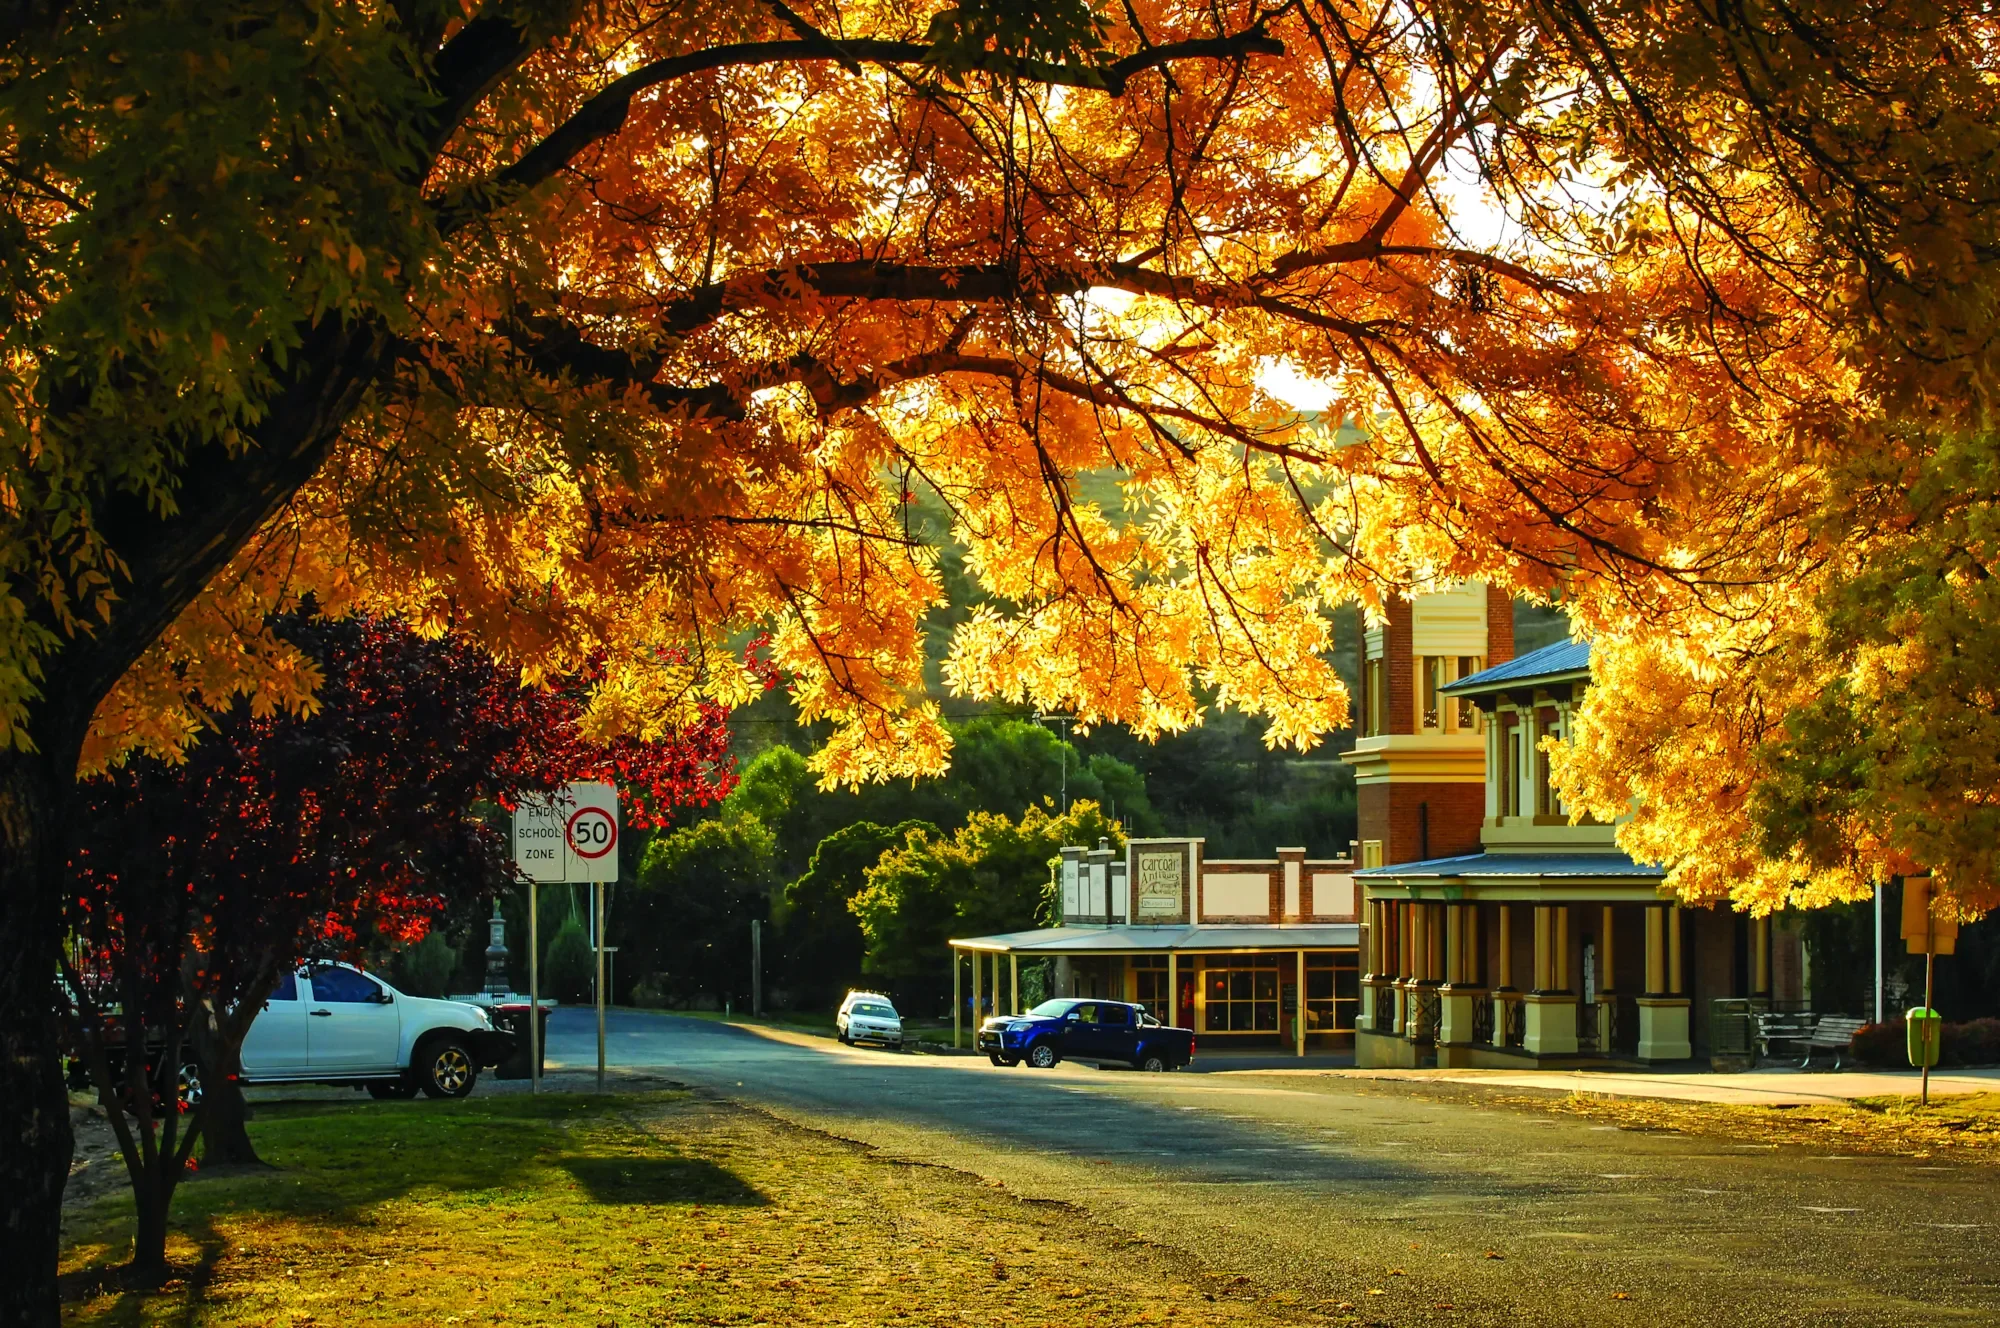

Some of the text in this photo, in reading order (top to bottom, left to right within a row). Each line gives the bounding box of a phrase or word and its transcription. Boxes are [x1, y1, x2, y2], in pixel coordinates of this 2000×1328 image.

[529, 807, 551, 817] END
[519, 828, 561, 838] SCHOOL
[576, 821, 608, 844] 50
[525, 849, 555, 859] ZONE
